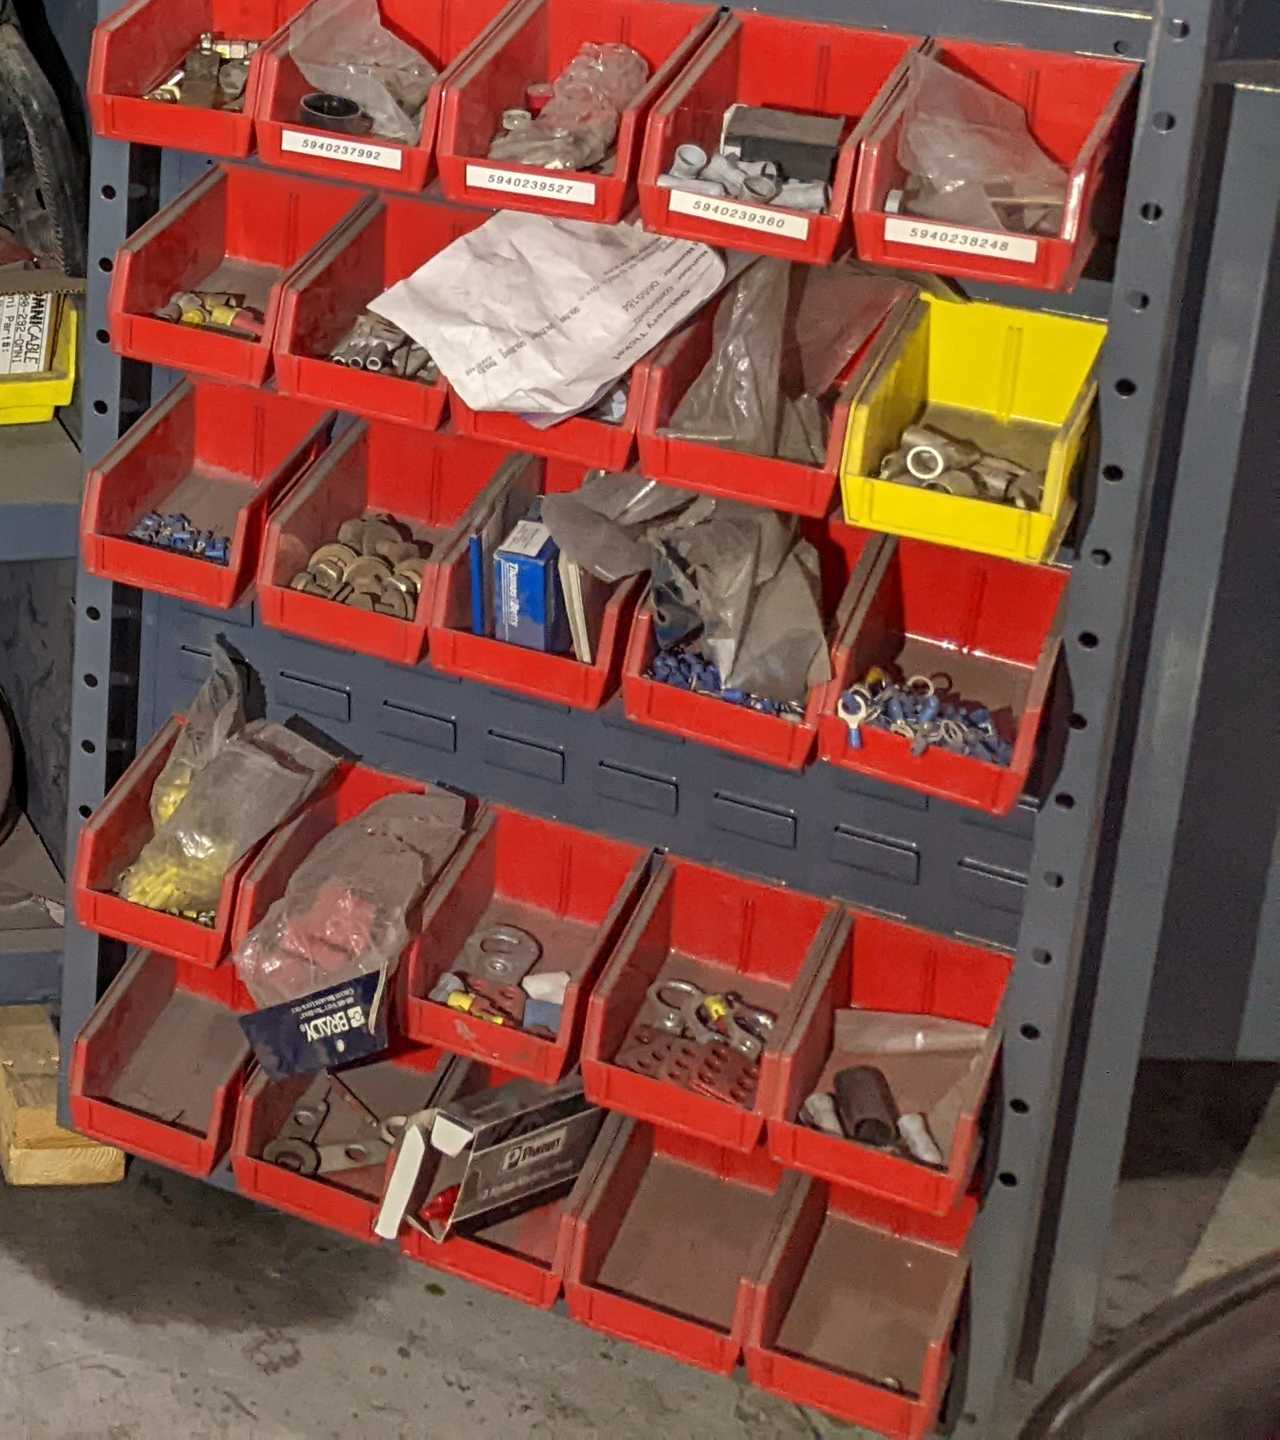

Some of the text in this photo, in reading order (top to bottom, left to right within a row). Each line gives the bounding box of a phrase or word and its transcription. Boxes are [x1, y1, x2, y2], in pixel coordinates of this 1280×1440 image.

[302, 138, 382, 161] 5940237992
[487, 174, 574, 196] 5940239527
[692, 200, 786, 229] 5940239360
[908, 227, 1010, 253] 5940238248
[647, 288, 691, 331] Delivery
[611, 329, 649, 361] Ticket
[304, 1012, 350, 1043] BRADY
